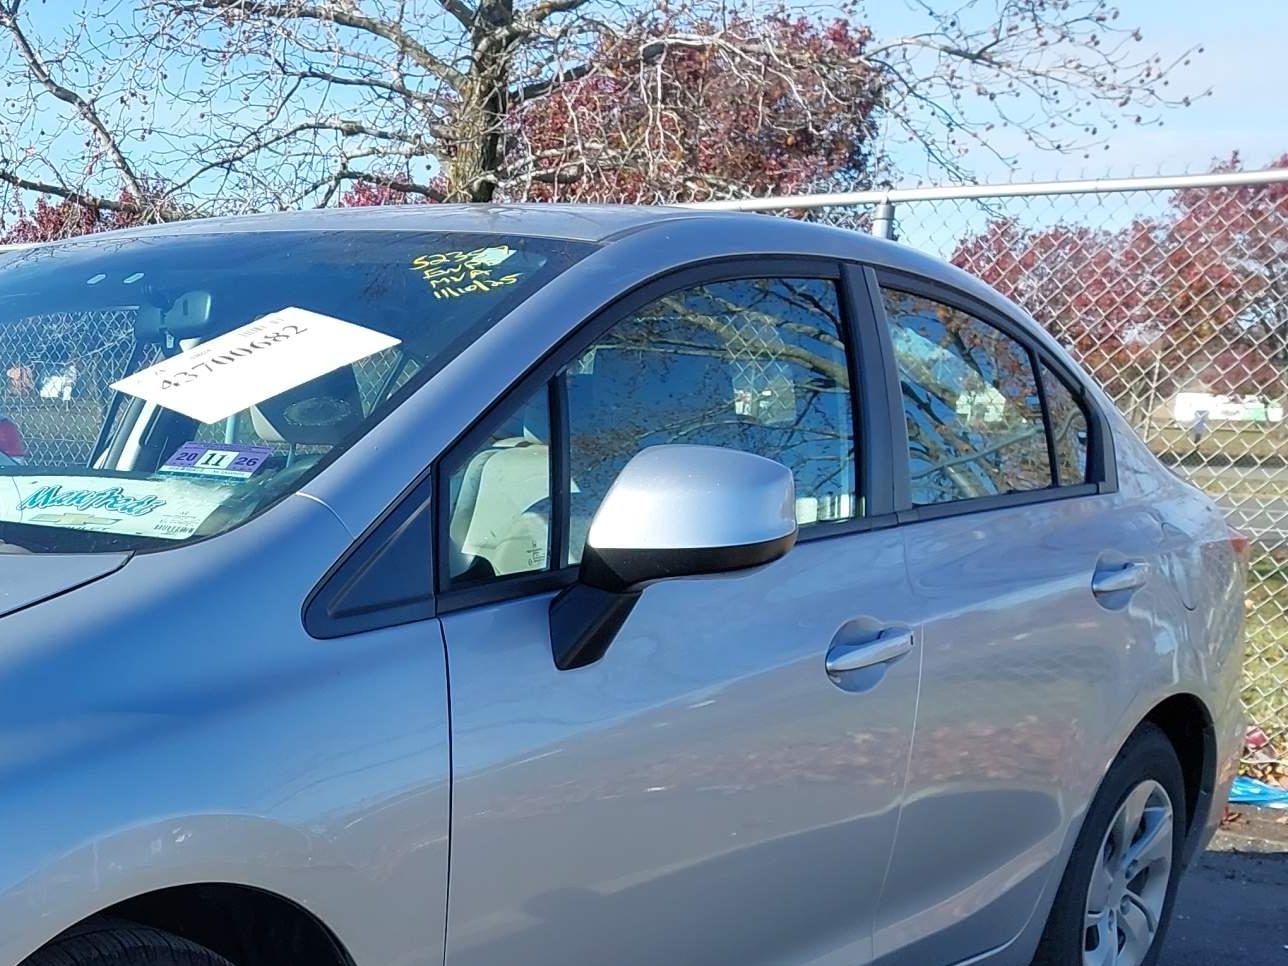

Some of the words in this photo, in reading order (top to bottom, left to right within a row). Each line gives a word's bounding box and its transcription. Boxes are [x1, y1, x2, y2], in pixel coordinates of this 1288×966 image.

[161, 324, 309, 391] 43700682
[175, 451, 199, 462] 20
[201, 452, 228, 467] 11
[235, 456, 260, 467] 26
